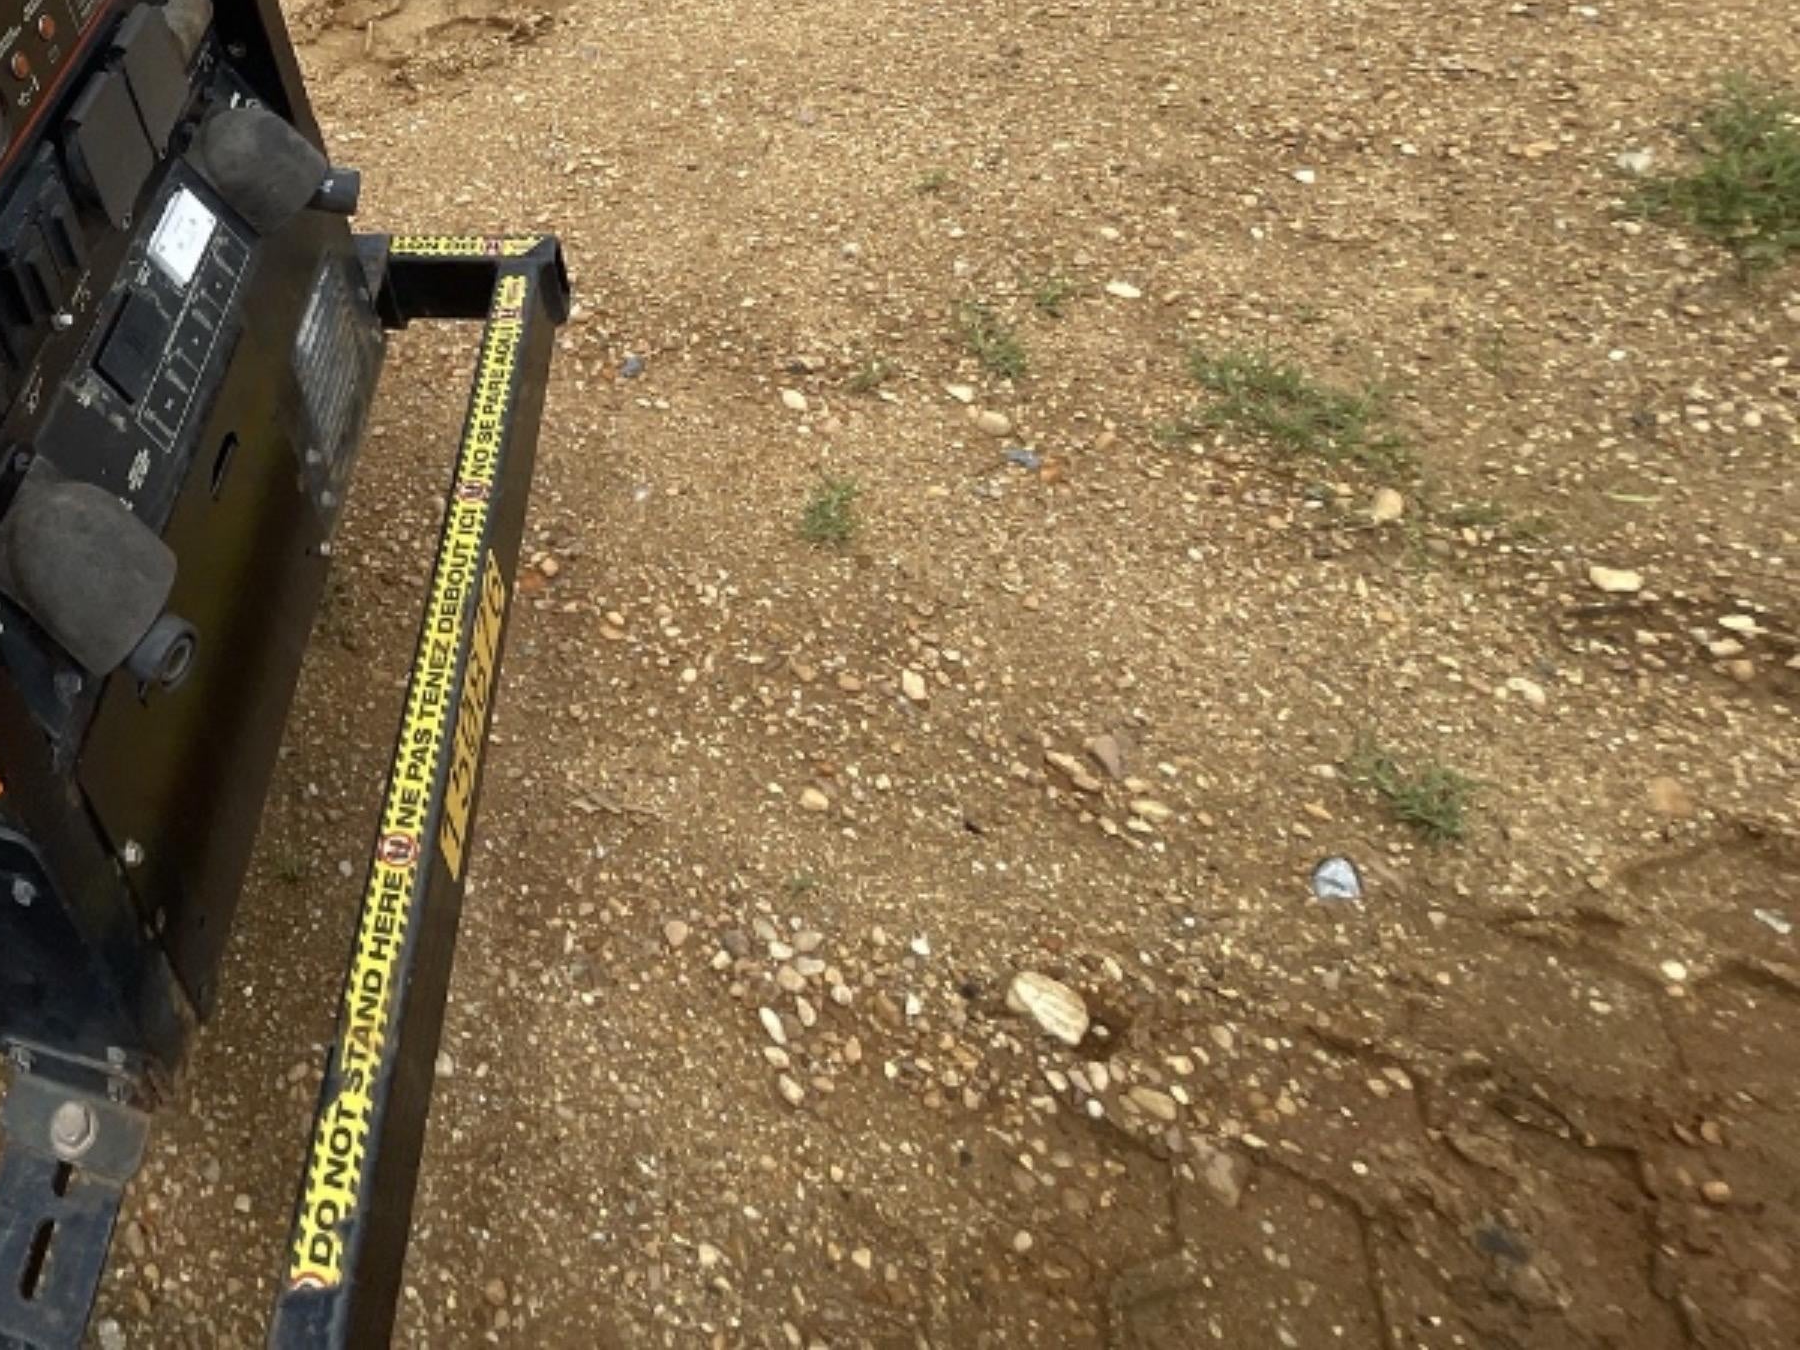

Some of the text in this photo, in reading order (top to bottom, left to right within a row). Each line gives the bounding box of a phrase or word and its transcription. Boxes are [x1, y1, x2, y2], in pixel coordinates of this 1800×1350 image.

[470, 449, 490, 477] NO
[477, 419, 496, 443] SE
[458, 507, 478, 537] ICI
[437, 541, 472, 634] DEBOUT
[417, 640, 450, 721] TENEZ
[406, 727, 433, 782] PAS
[397, 786, 421, 828] NE
[368, 870, 404, 961] HERE
[346, 968, 383, 1094] STAND
[323, 1100, 359, 1189] NOT
[307, 1198, 340, 1267] DO
